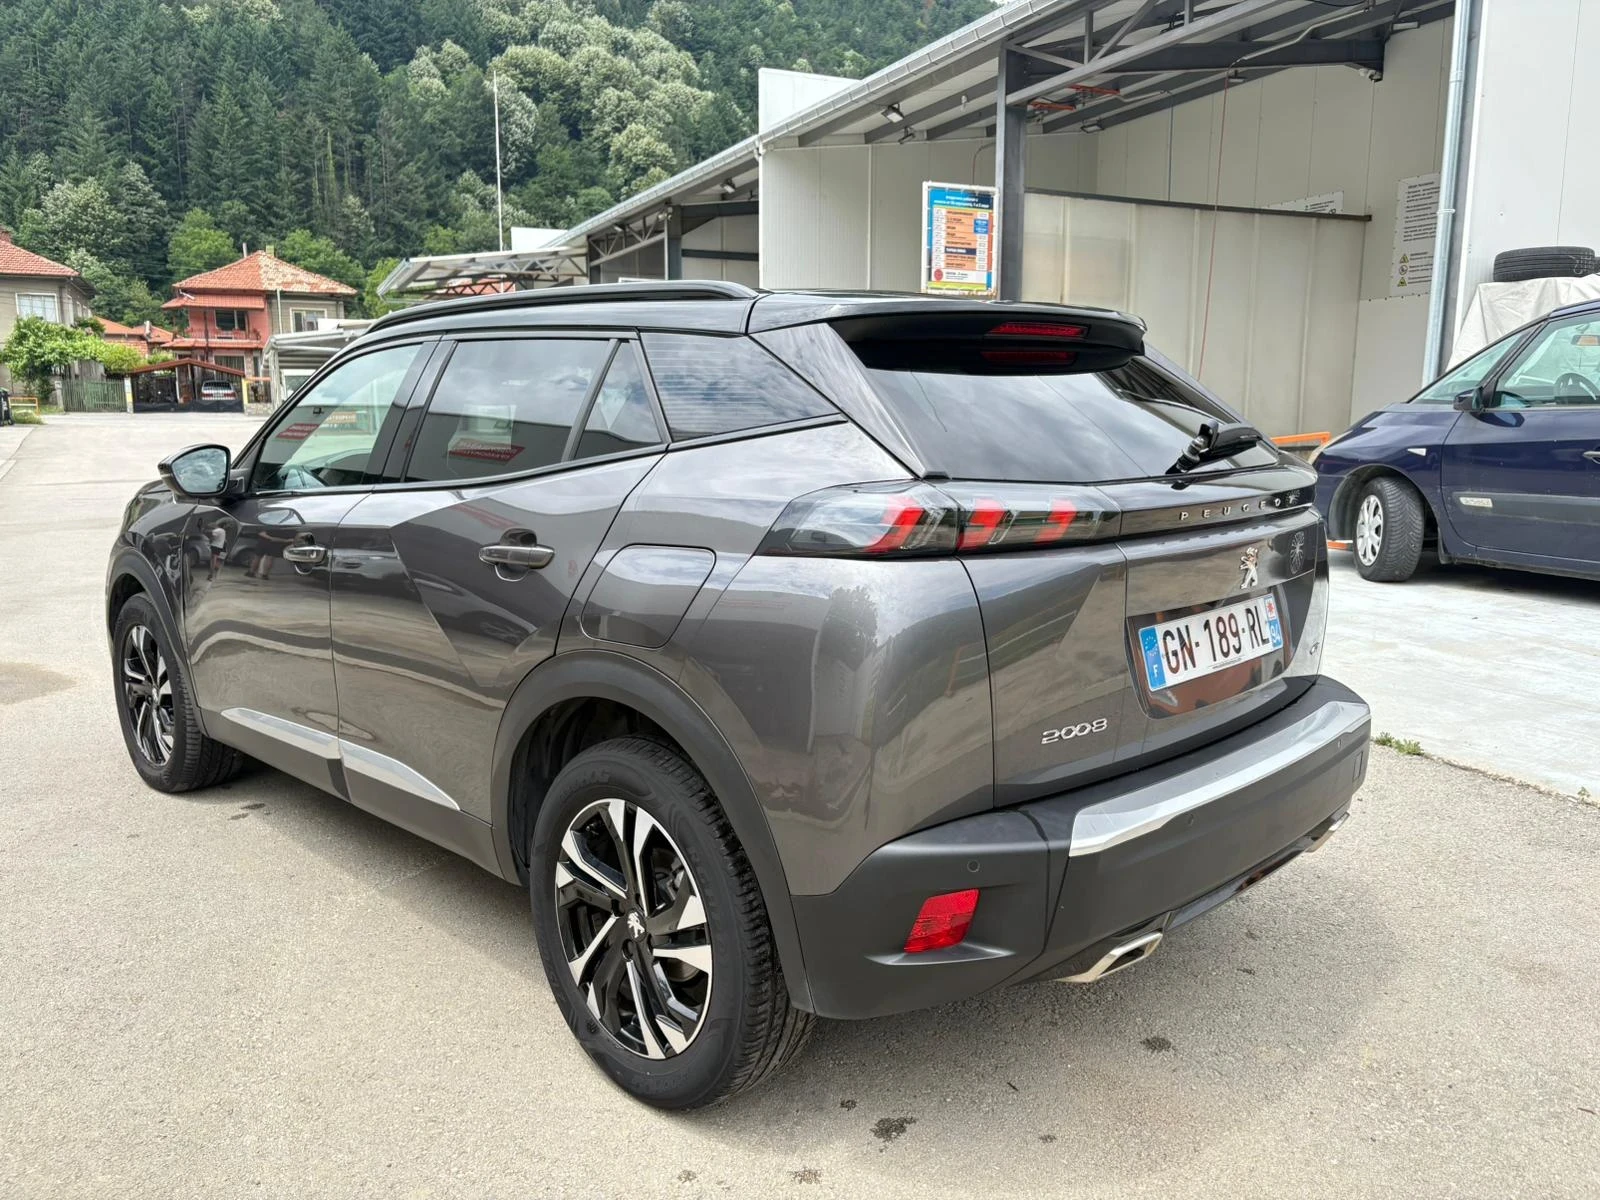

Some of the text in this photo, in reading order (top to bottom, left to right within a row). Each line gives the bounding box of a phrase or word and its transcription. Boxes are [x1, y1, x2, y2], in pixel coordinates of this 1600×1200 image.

[1180, 495, 1297, 521] PEUGEOT
[1152, 664, 1159, 678] F
[1041, 718, 1108, 745] 2008
